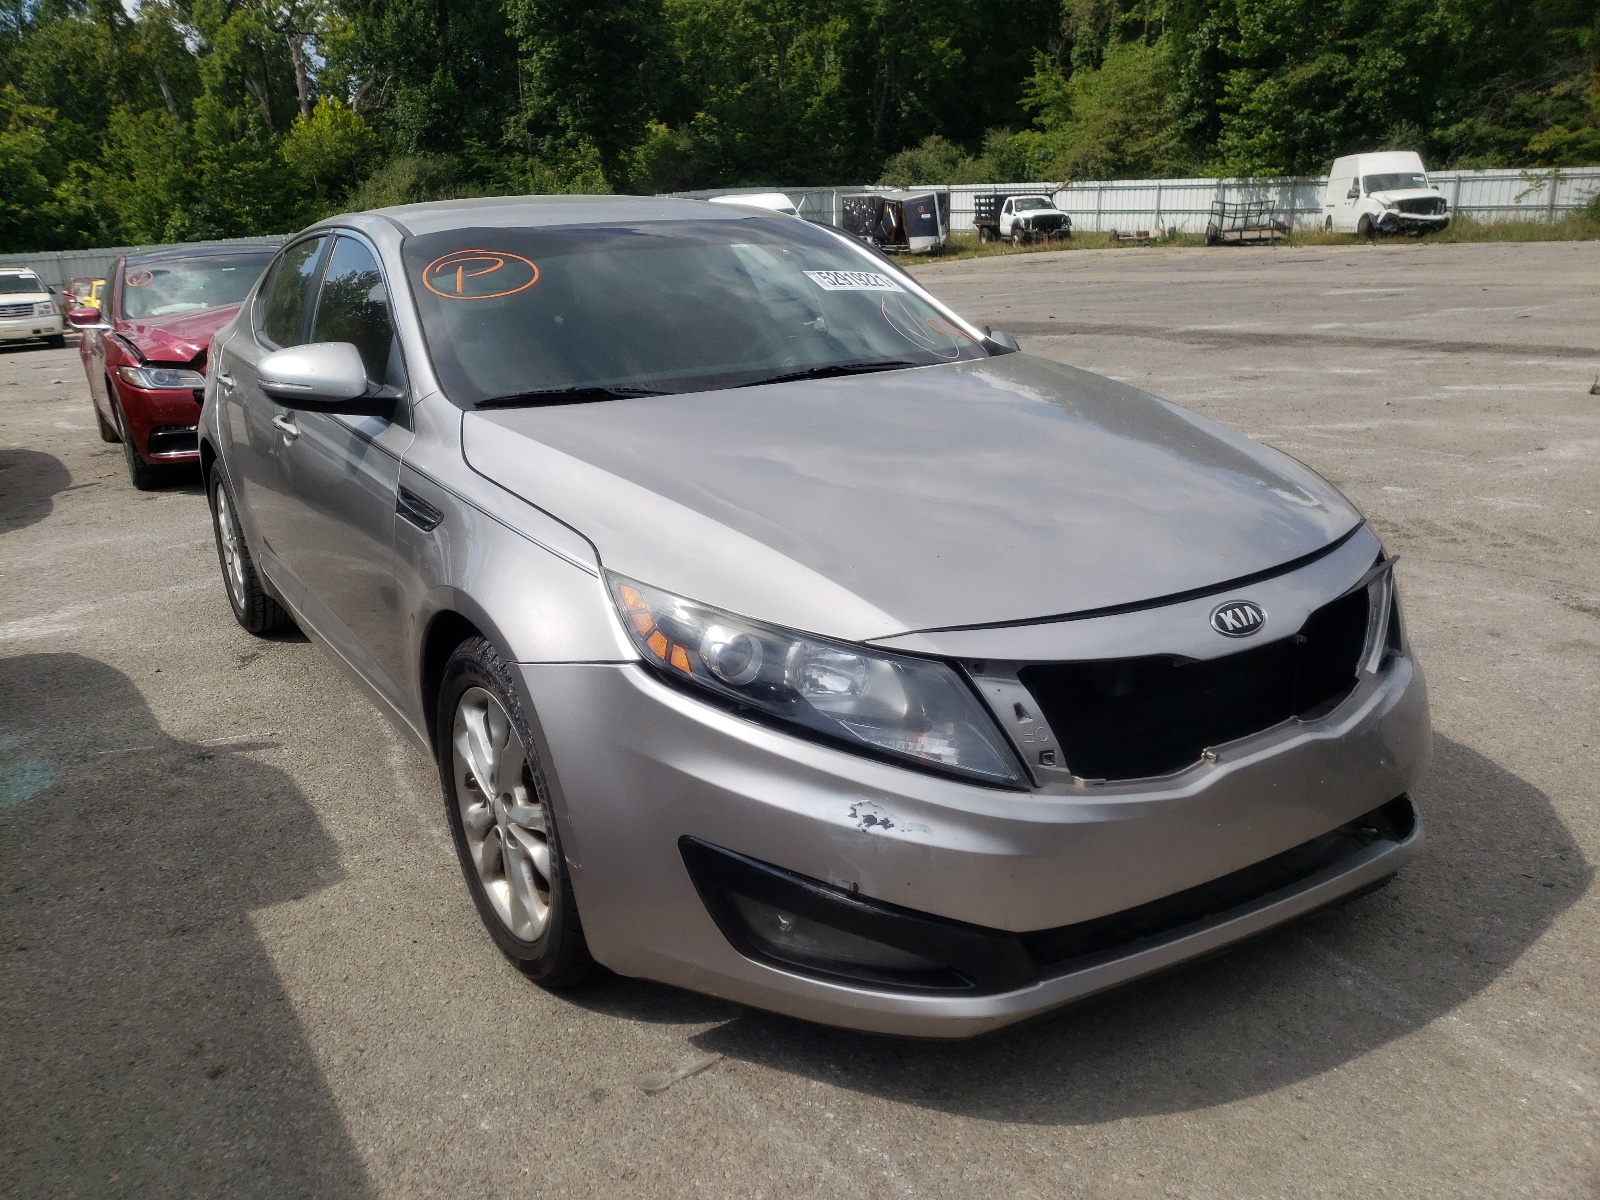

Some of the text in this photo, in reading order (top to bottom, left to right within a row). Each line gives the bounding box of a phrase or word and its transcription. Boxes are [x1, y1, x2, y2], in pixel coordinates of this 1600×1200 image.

[435, 256, 504, 295] P
[816, 271, 889, 287] 52919221
[1218, 605, 1262, 631] KIA
